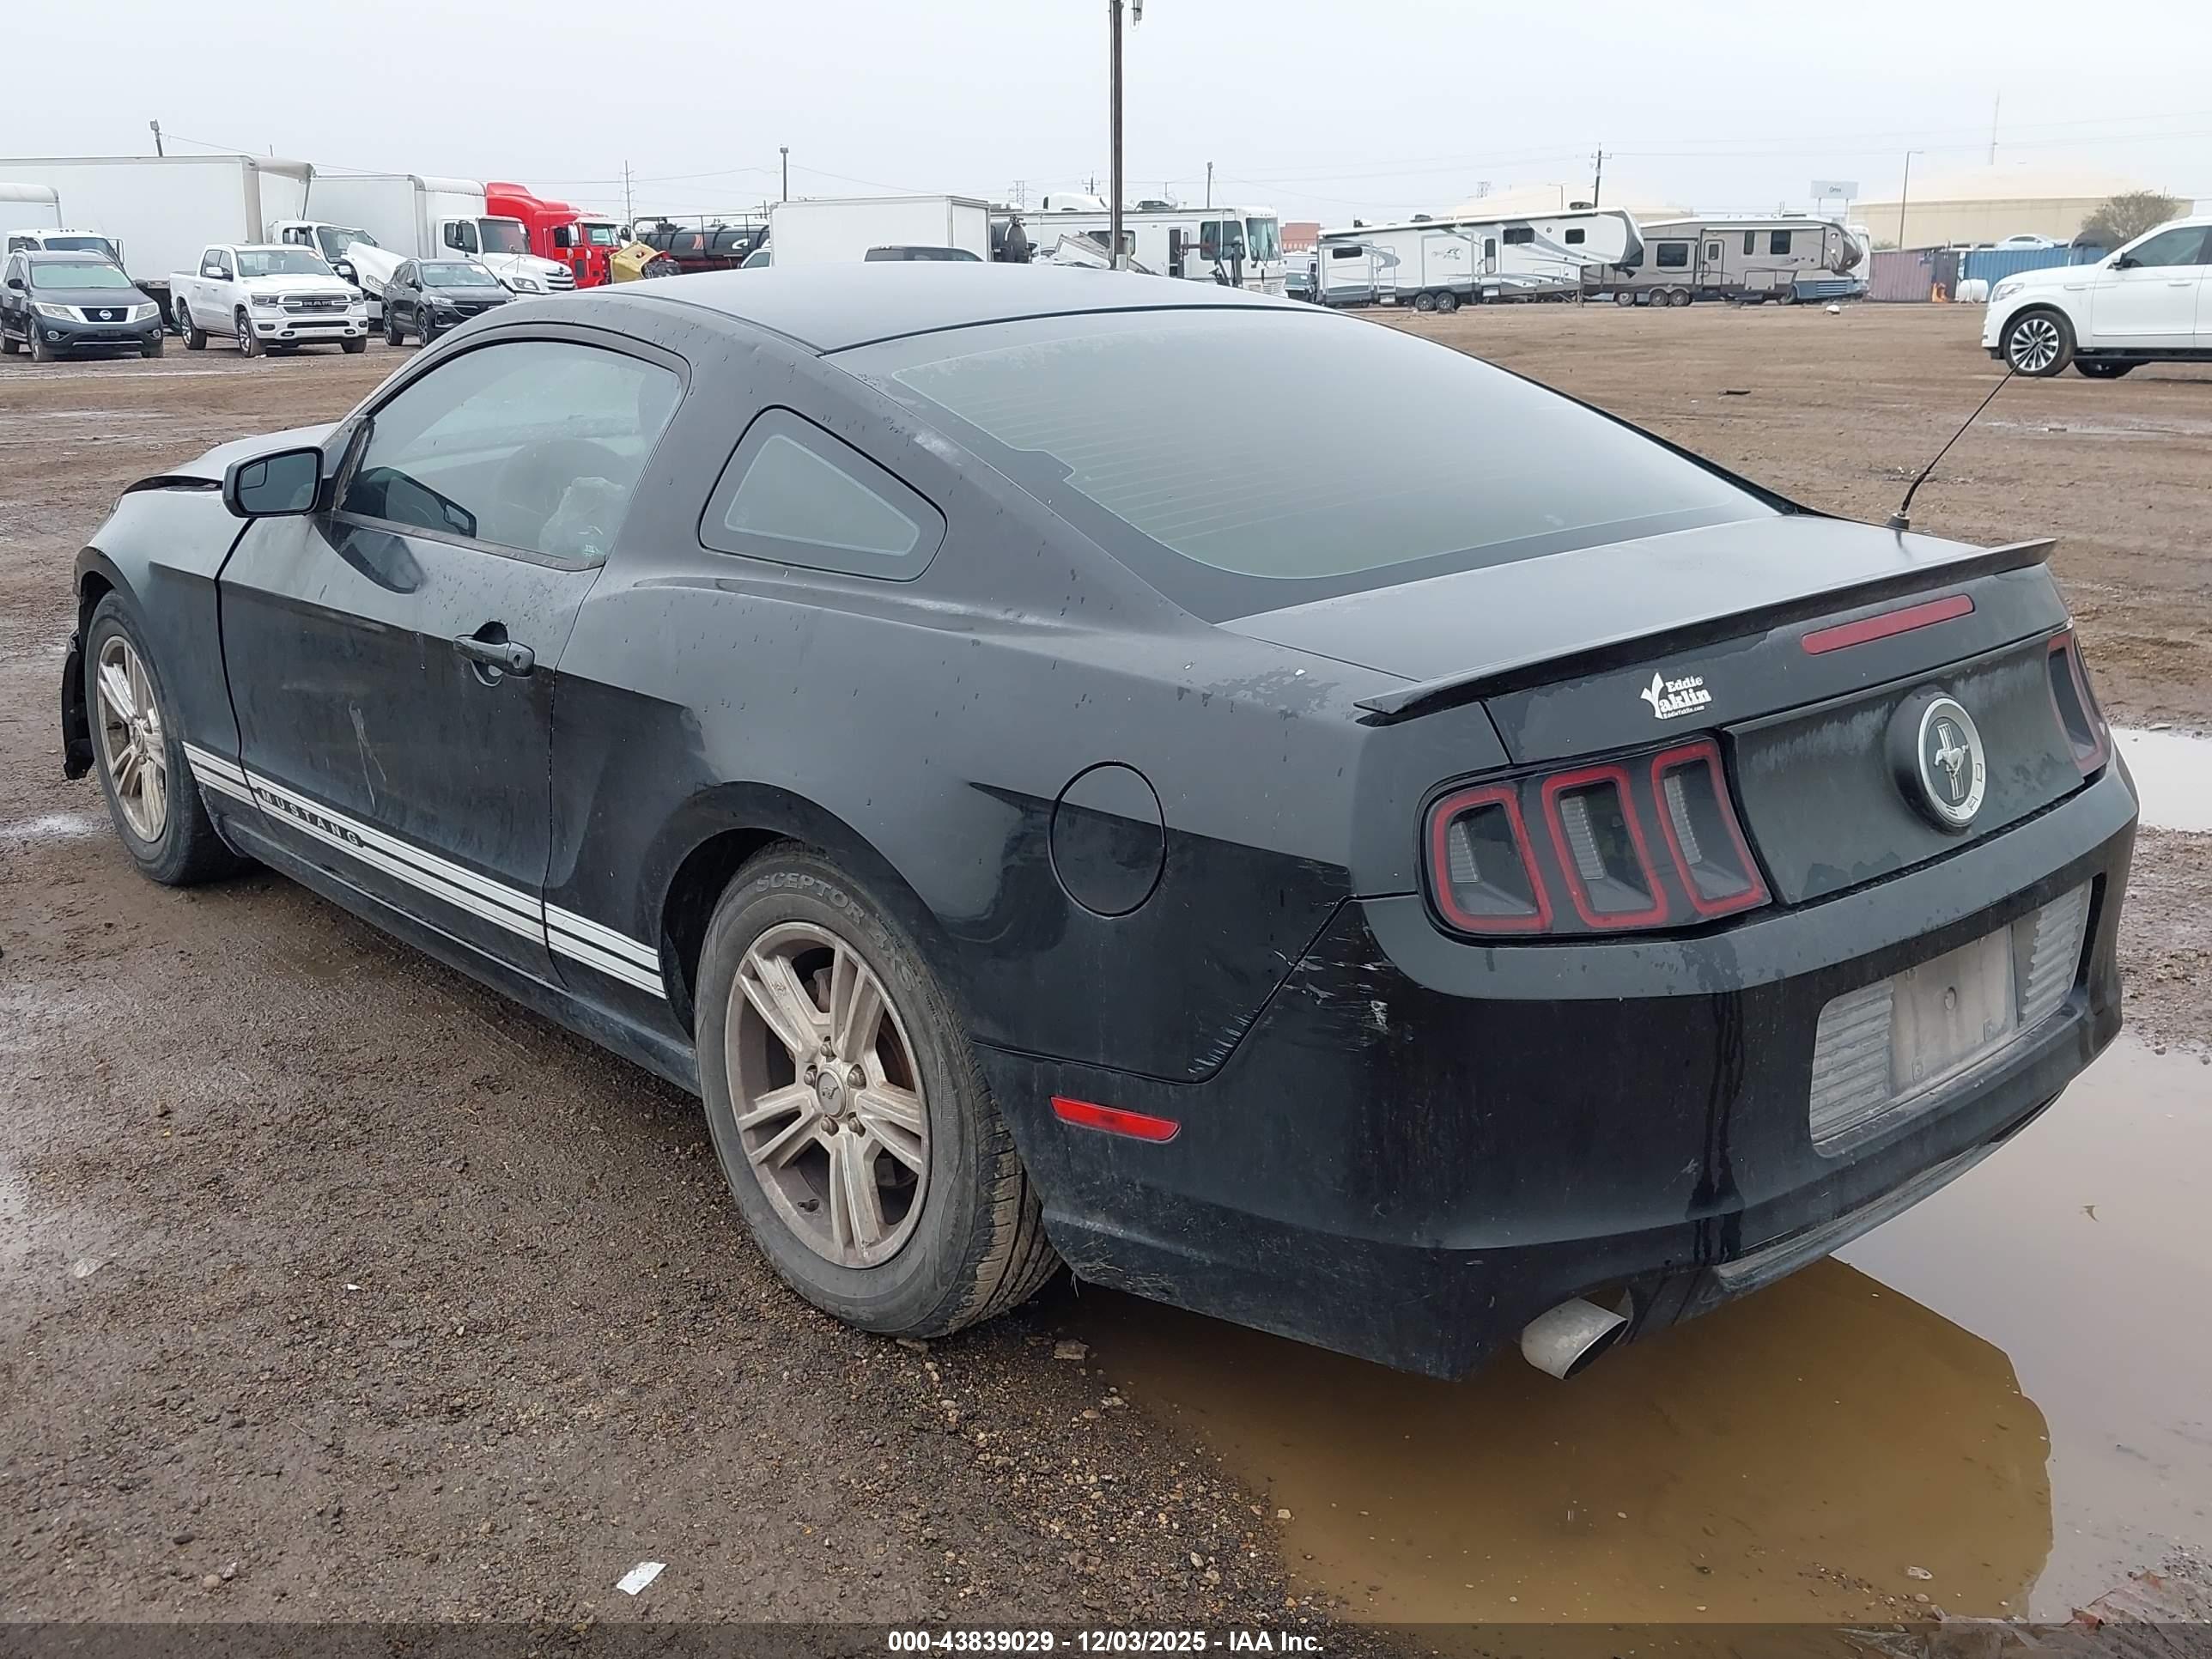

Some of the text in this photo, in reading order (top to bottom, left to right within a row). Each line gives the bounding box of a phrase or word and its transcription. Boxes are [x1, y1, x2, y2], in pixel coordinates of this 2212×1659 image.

[1665, 676, 1704, 693] Eddie
[260, 789, 359, 845] MUSTANG
[756, 872, 866, 925] SCEPTOR
